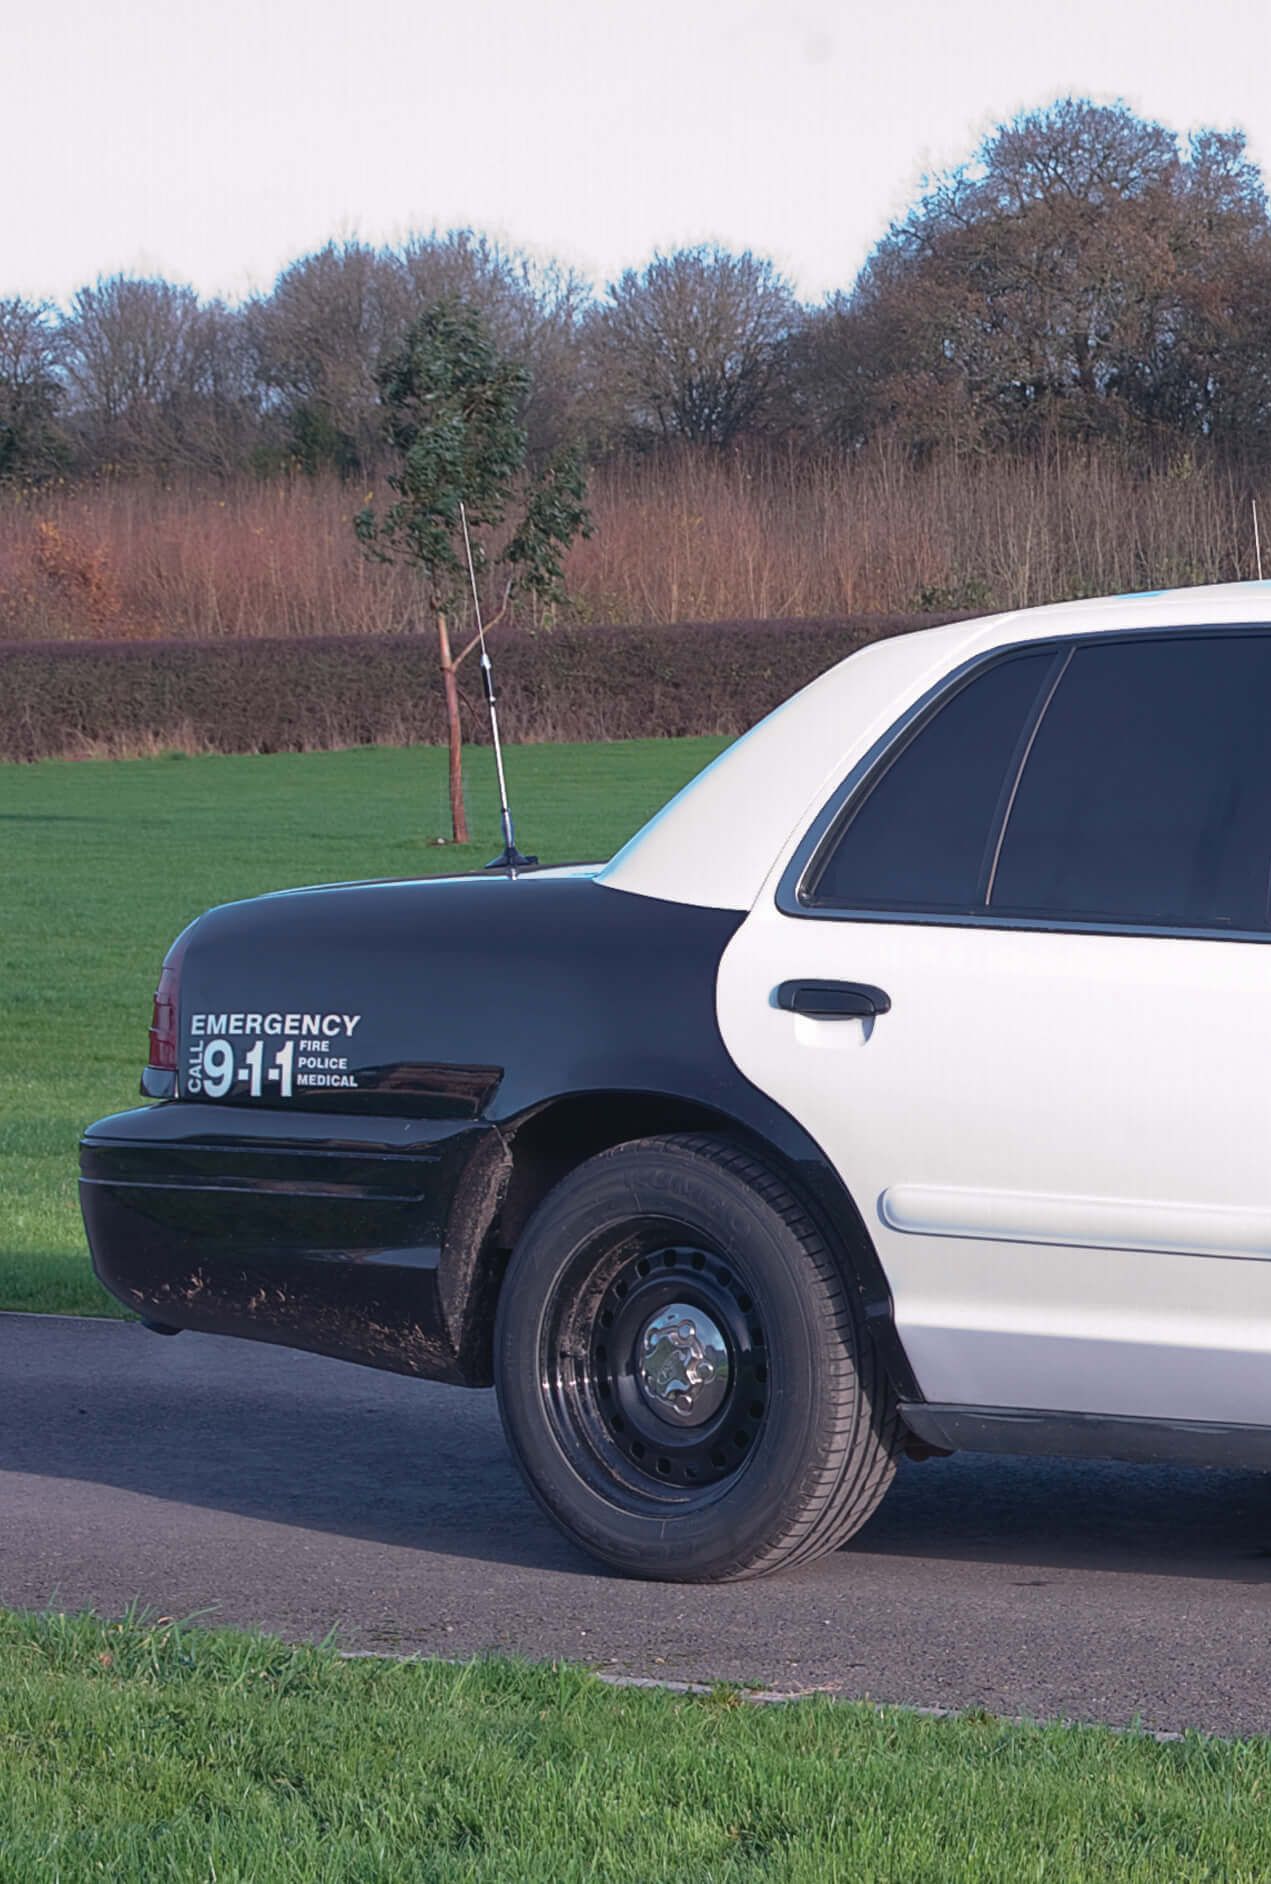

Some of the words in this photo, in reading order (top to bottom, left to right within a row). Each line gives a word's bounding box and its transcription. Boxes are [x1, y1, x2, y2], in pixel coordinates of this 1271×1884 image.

[191, 1013, 361, 1036] EMERGENCY
[299, 1040, 329, 1052] FIRE
[188, 1040, 204, 1093] CALL
[298, 1057, 348, 1069] POLICE
[297, 1074, 358, 1087] MEDICAL
